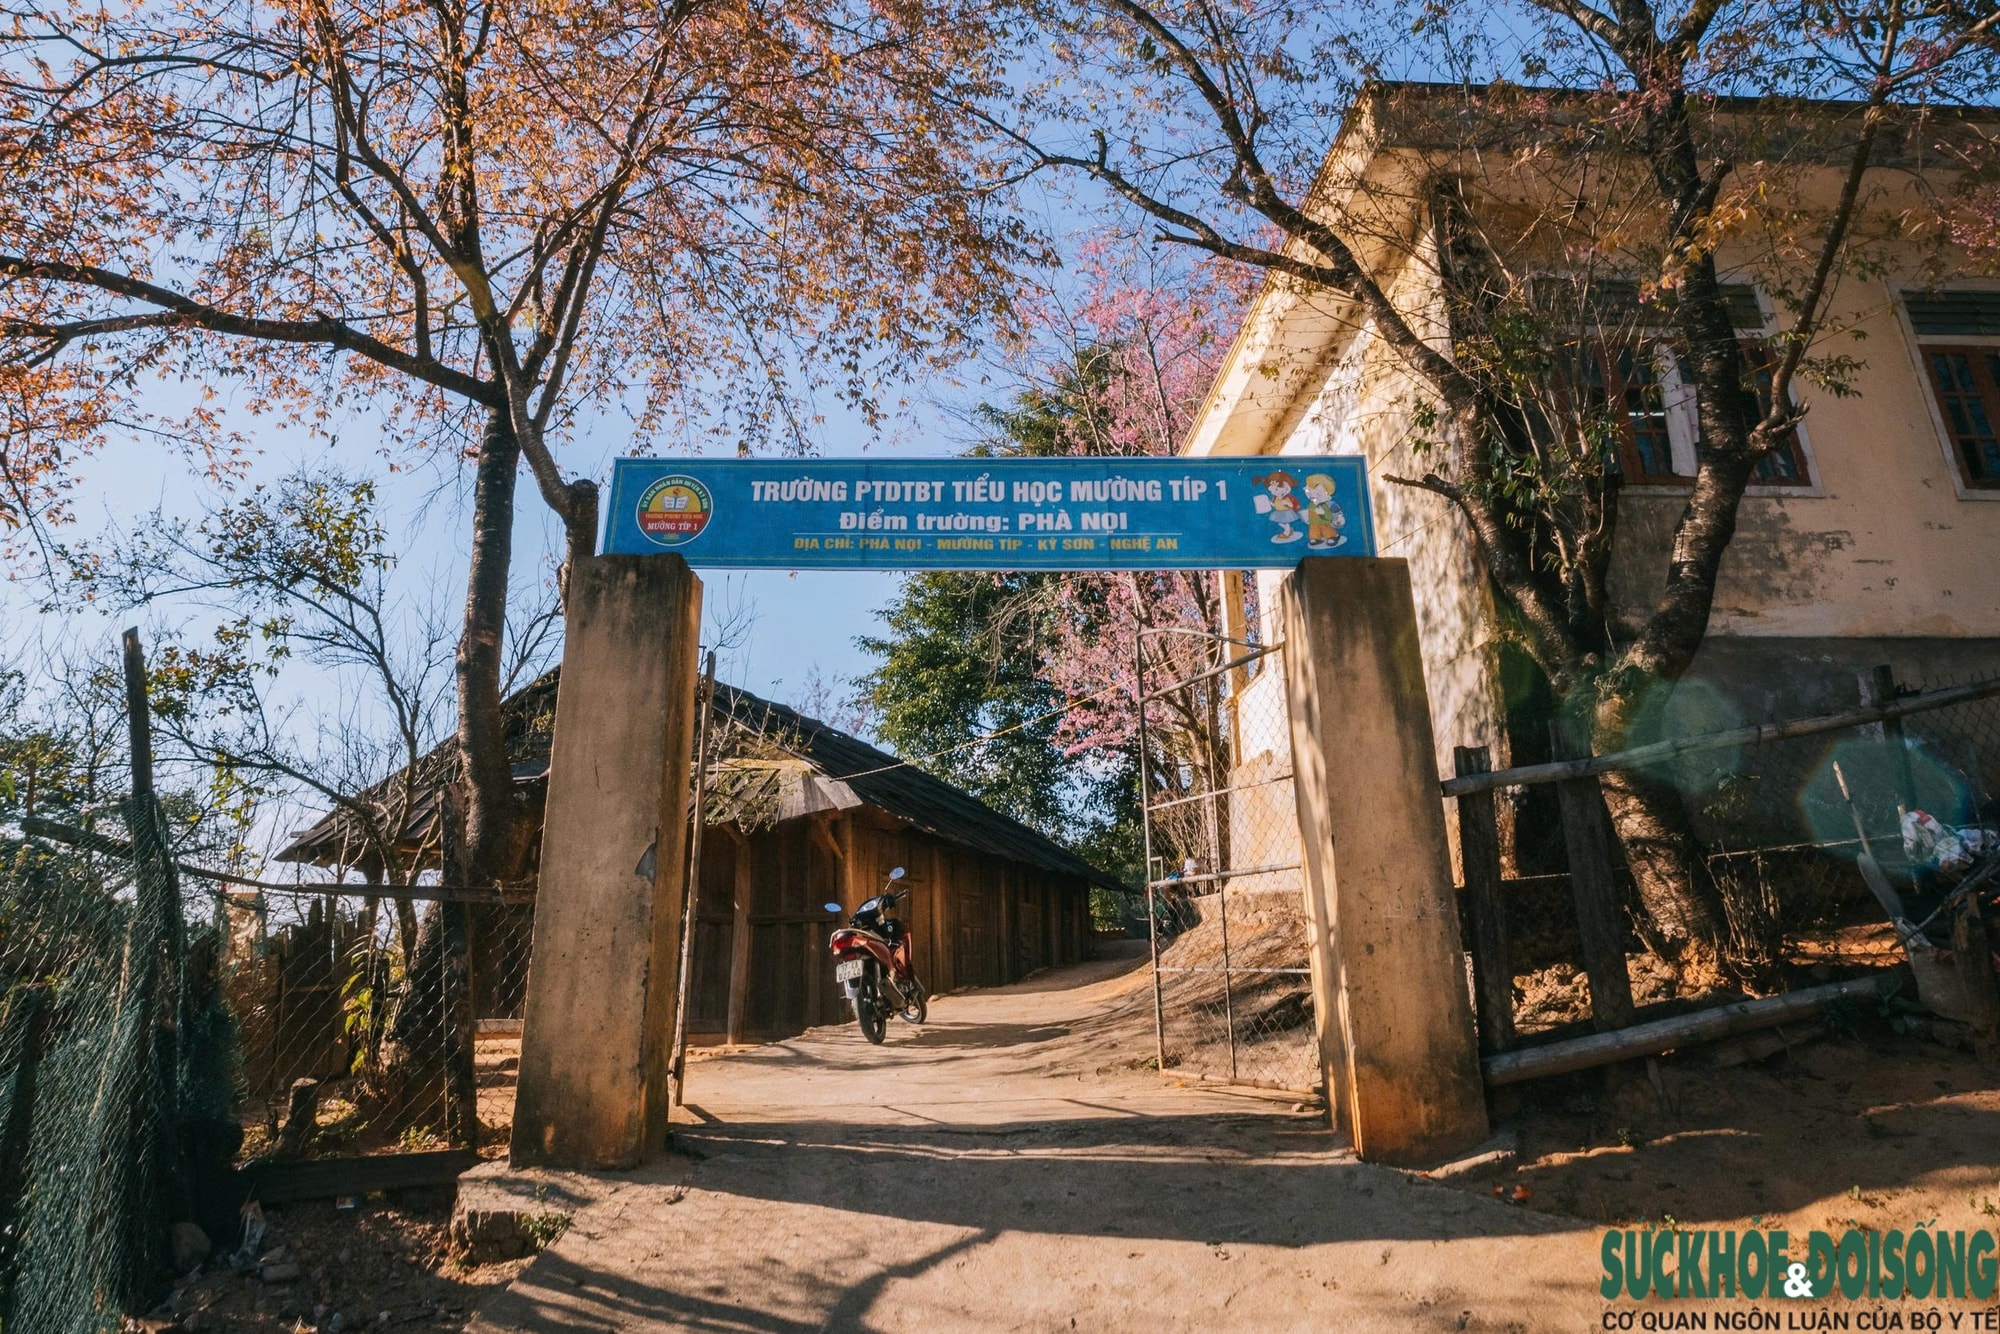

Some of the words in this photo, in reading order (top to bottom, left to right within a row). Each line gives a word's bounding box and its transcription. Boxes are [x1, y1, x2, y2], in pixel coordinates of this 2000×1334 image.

[751, 476, 848, 502] TRƯỜNG
[855, 481, 945, 503] PTDTBT
[952, 472, 1005, 503] TIỂU
[1013, 481, 1063, 507] HỌC
[1070, 475, 1162, 502] MƯỜNG
[1168, 475, 1208, 502] TÍP
[1215, 480, 1227, 501] 1
[647, 520, 676, 530] MƯỜNG
[678, 520, 692, 531] TÍP
[693, 523, 698, 531] 1
[839, 507, 907, 531] Điểm
[916, 512, 1009, 533] trường:
[1018, 509, 1073, 531] PHÀ
[1081, 512, 1128, 534] NỌI
[794, 537, 820, 552] ĐỊA
[894, 538, 922, 553] NỌI
[936, 535, 994, 551] MƯỜNG
[998, 536, 1022, 551] TÍP
[1062, 537, 1094, 551] SƠN
[1110, 535, 1151, 553] NGHỆ
[1156, 538, 1178, 551] AN
